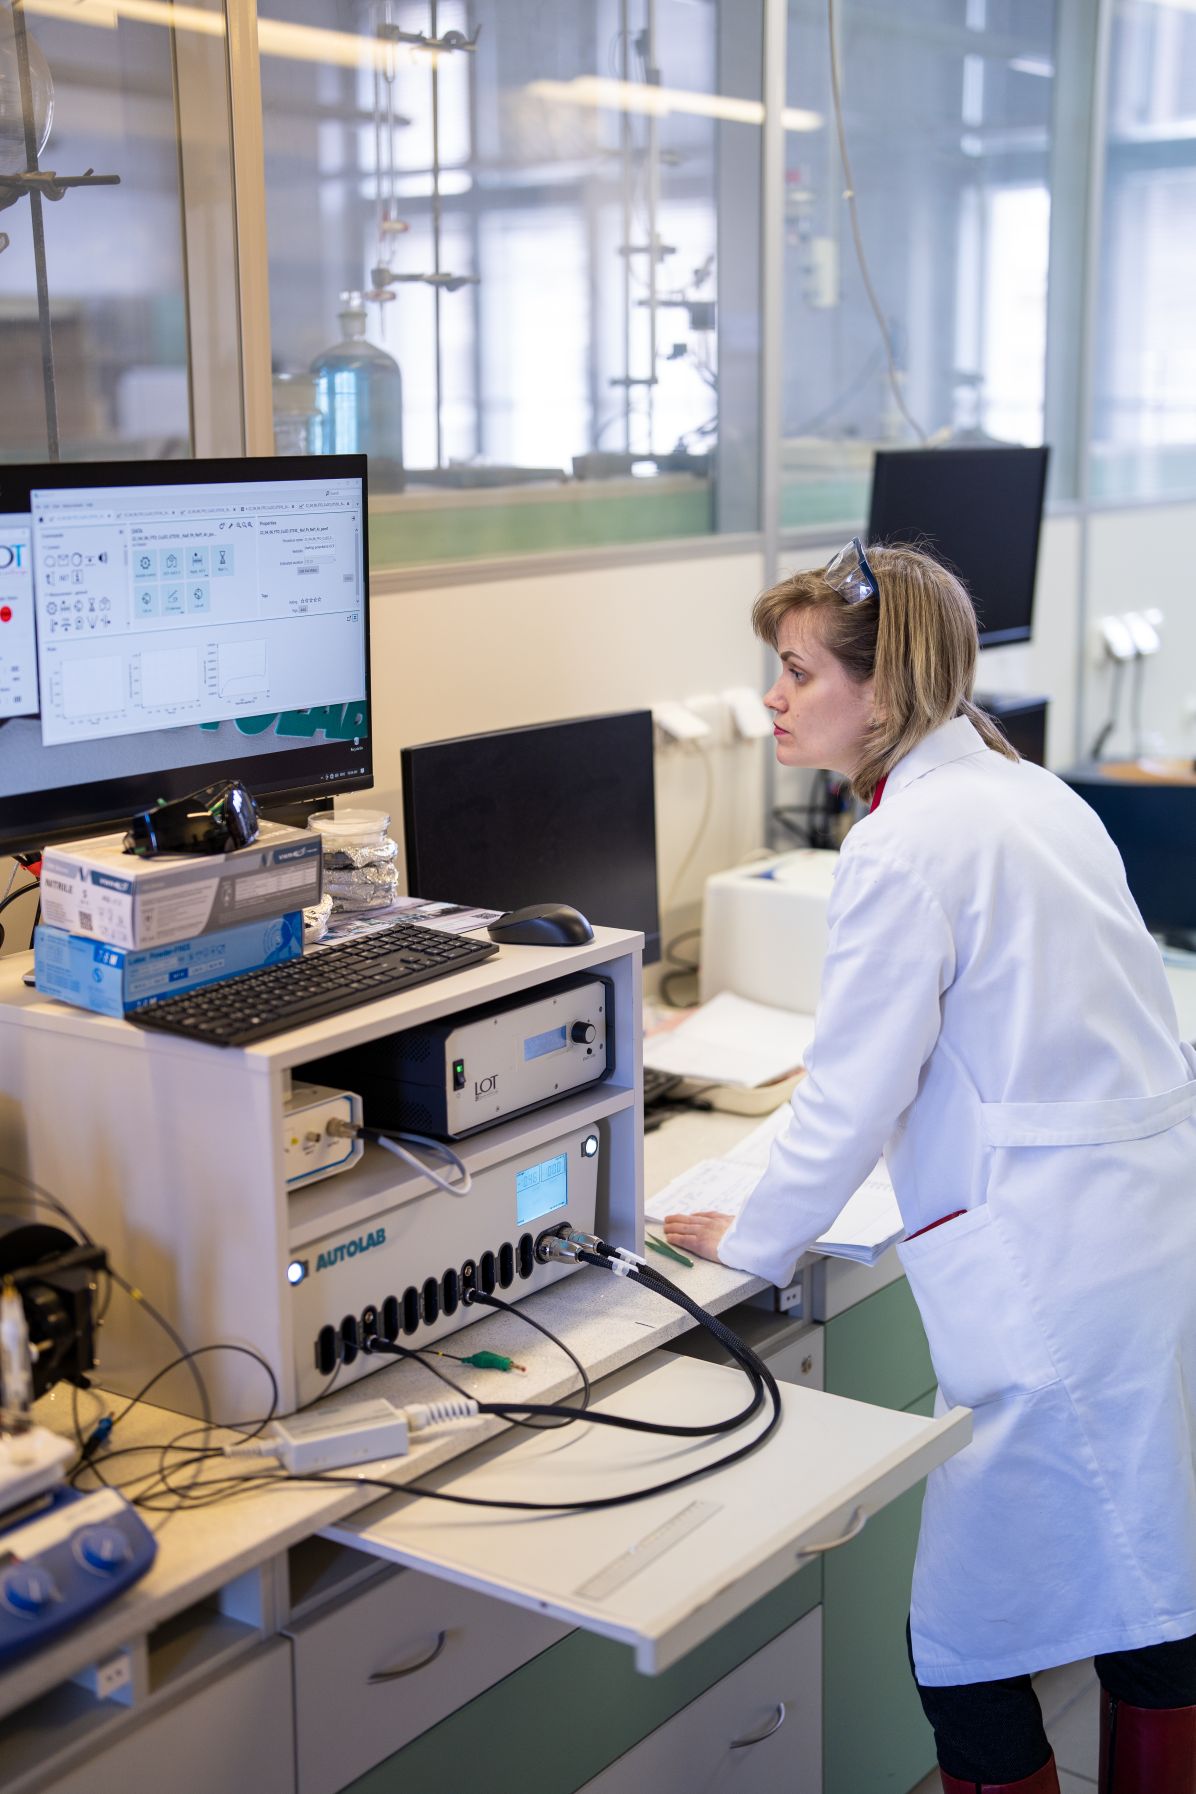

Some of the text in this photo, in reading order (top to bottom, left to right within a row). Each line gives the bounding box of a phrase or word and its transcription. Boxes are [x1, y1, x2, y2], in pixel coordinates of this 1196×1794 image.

[45, 878, 73, 895] NITRILE
[474, 1074, 499, 1097] LOT
[316, 1227, 386, 1272] AUTOLAB
